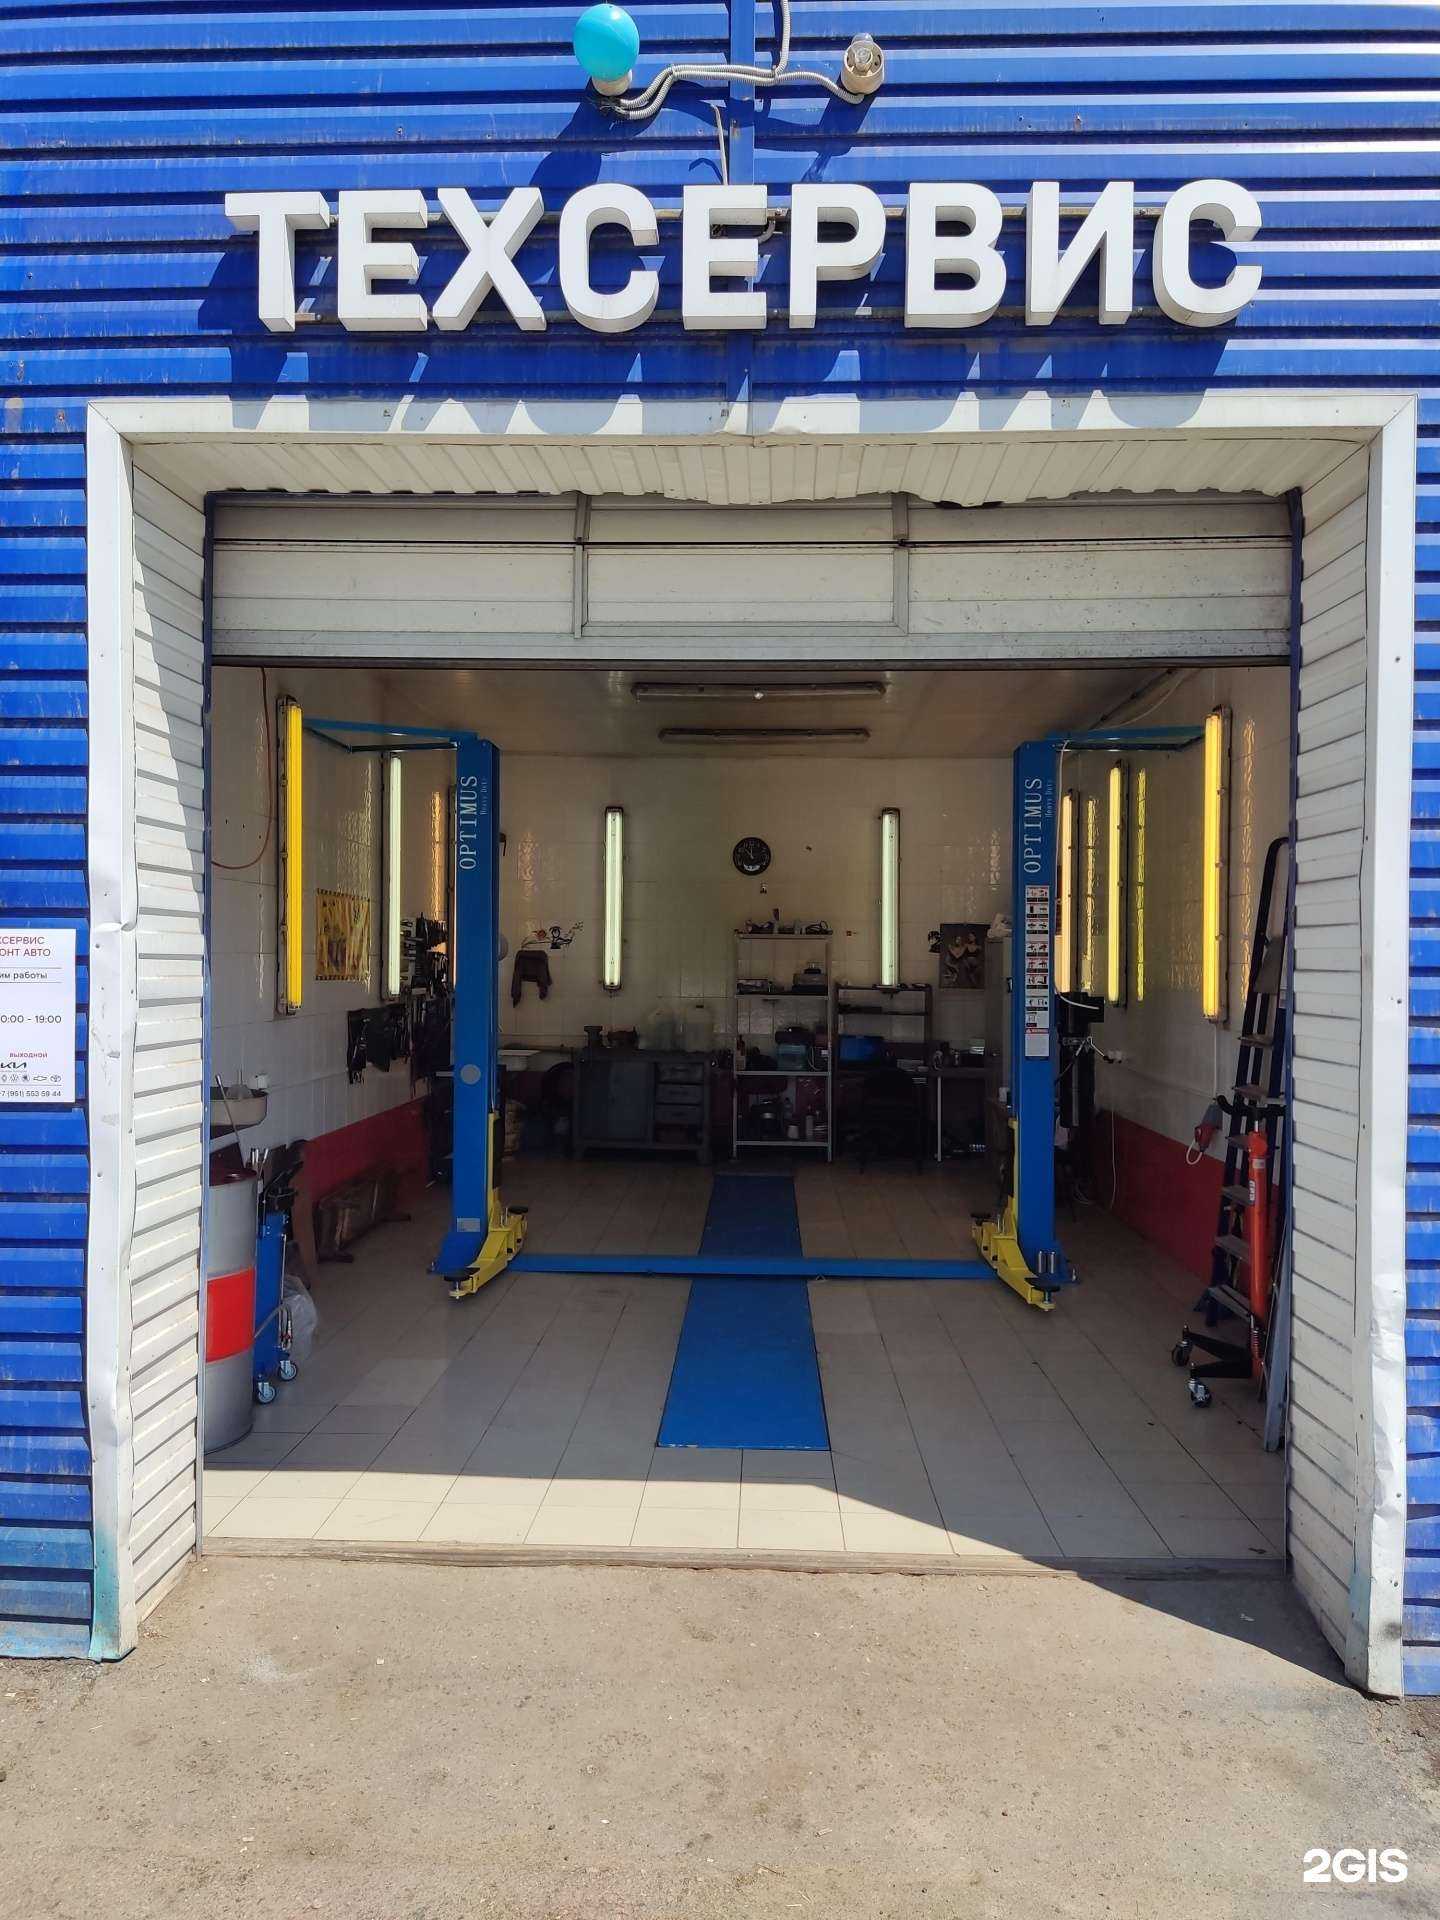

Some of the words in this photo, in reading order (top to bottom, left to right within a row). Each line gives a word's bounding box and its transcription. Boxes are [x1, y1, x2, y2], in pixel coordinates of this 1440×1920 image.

[225, 180, 1264, 333] ТЕХСЕРВИС
[459, 776, 478, 870] OPTIMUS
[1024, 778, 1042, 873] OPTIMUS
[13, 971, 48, 981] работы
[23, 948, 51, 957] АВТО
[35, 1014, 62, 1024] 19:00
